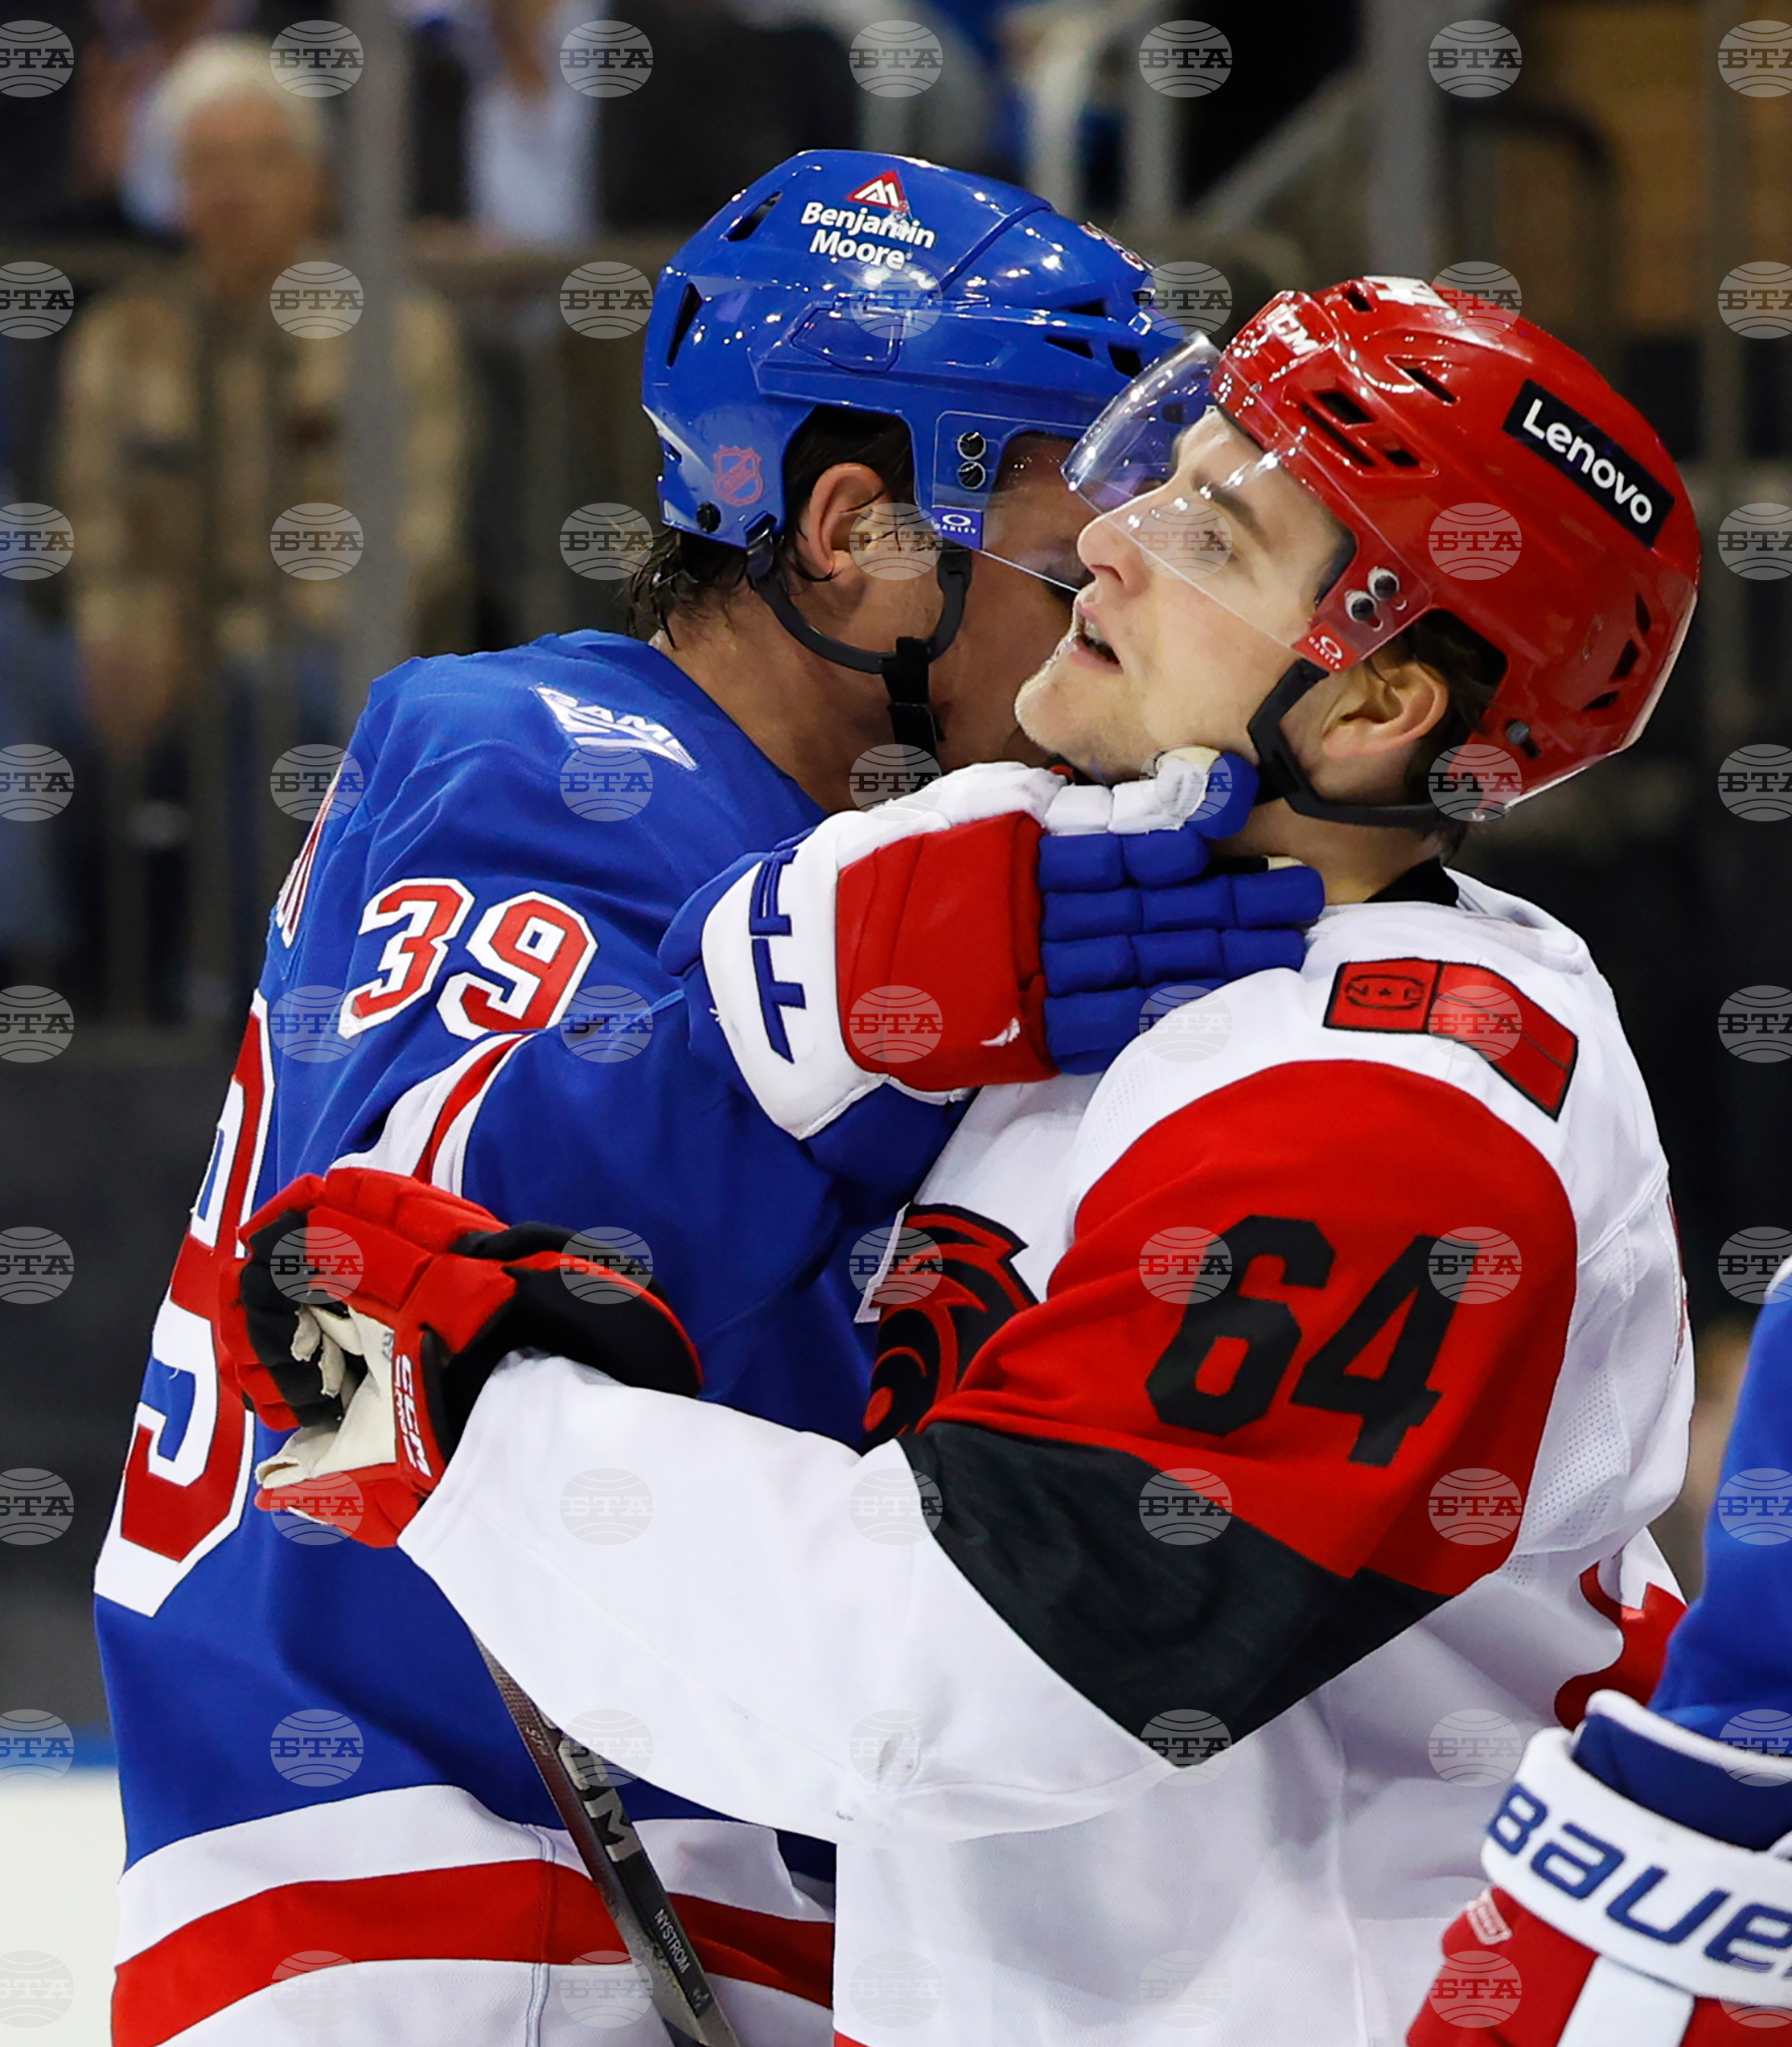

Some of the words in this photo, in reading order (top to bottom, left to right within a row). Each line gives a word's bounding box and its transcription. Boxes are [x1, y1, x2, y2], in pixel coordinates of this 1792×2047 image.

[800, 201, 936, 249] Benjamin
[809, 228, 906, 270] Moore
[1522, 397, 1653, 524] Lenovo
[337, 877, 599, 1042] 39
[1145, 1214, 1480, 1468] 64
[654, 1908, 691, 1974] NYSTROM
[1488, 1782, 1792, 1978] Baue
